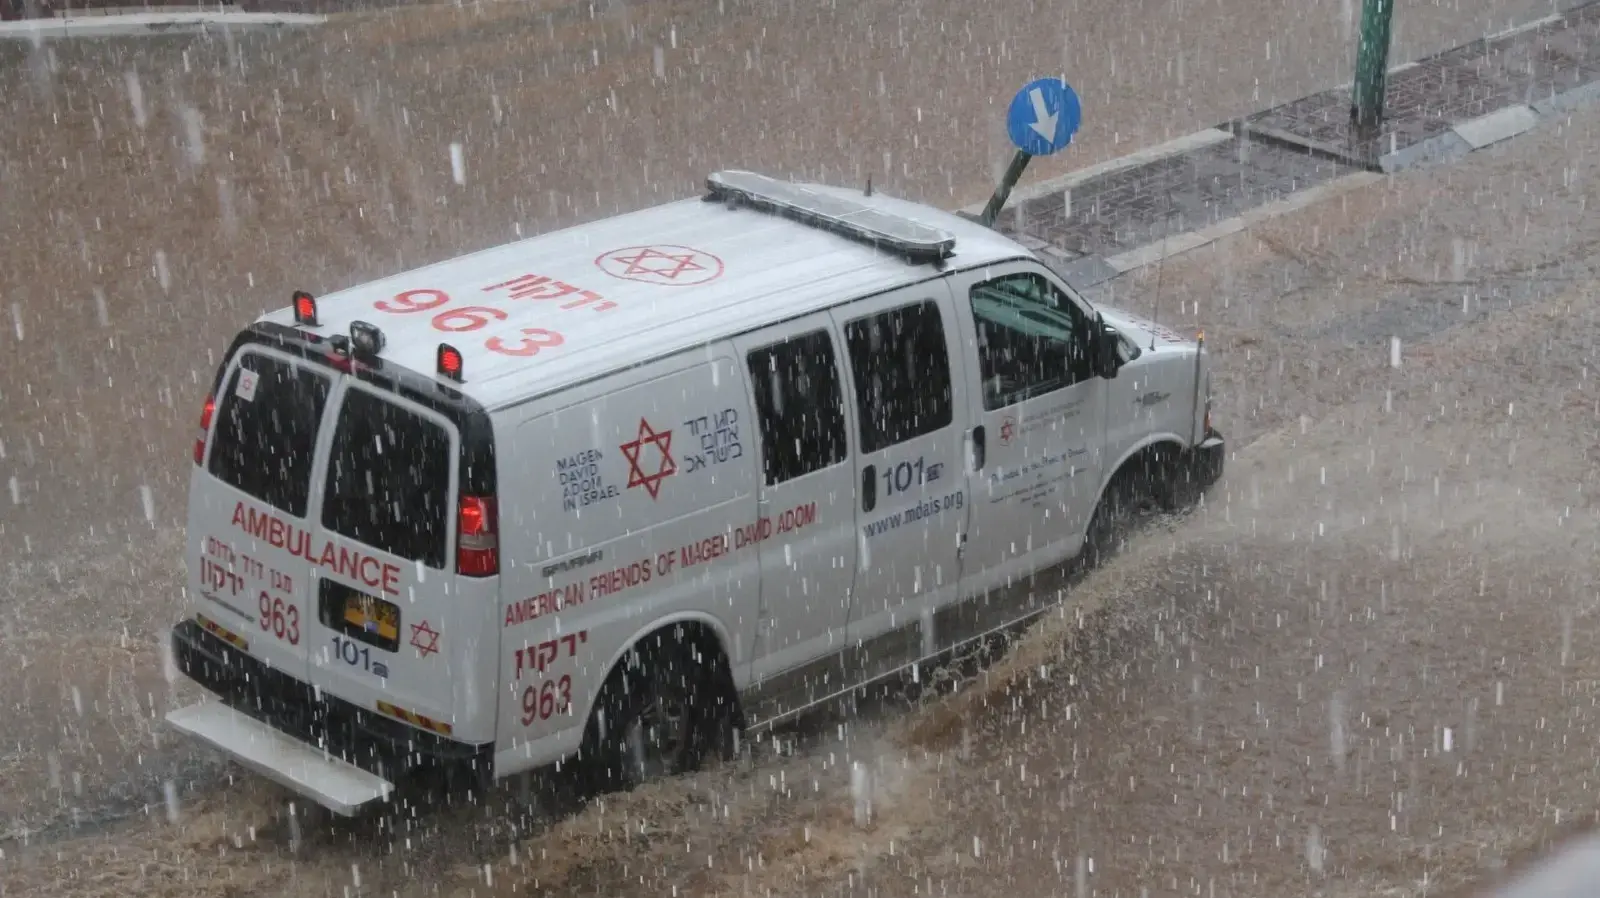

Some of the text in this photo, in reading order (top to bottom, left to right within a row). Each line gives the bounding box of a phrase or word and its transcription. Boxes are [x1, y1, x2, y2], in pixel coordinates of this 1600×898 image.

[480, 273, 619, 312] ירקון
[374, 288, 565, 357] 963
[683, 416, 708, 437] דוד
[701, 424, 739, 451] אדום
[556, 448, 603, 470] MAGEN
[560, 463, 598, 486] DAVID
[683, 442, 743, 474] בישראל
[882, 455, 924, 497] 101
[563, 475, 602, 498] ADOM
[563, 484, 621, 513] IN ISRAEL
[863, 489, 964, 539] www.mdais.org
[208, 536, 292, 594] מגן דוד אדום
[231, 501, 401, 595] AMBULANCE
[504, 580, 585, 627] AMERICAN
[589, 558, 652, 600] FRIENDS
[657, 550, 676, 577] OF
[680, 533, 730, 569] MAGEN
[734, 516, 773, 551] DAVID
[777, 501, 817, 533] ADOM
[200, 556, 245, 597] ירקון
[259, 590, 300, 645] 963
[331, 636, 370, 671] 101
[514, 630, 588, 680] ירקון
[521, 674, 572, 727] 963
